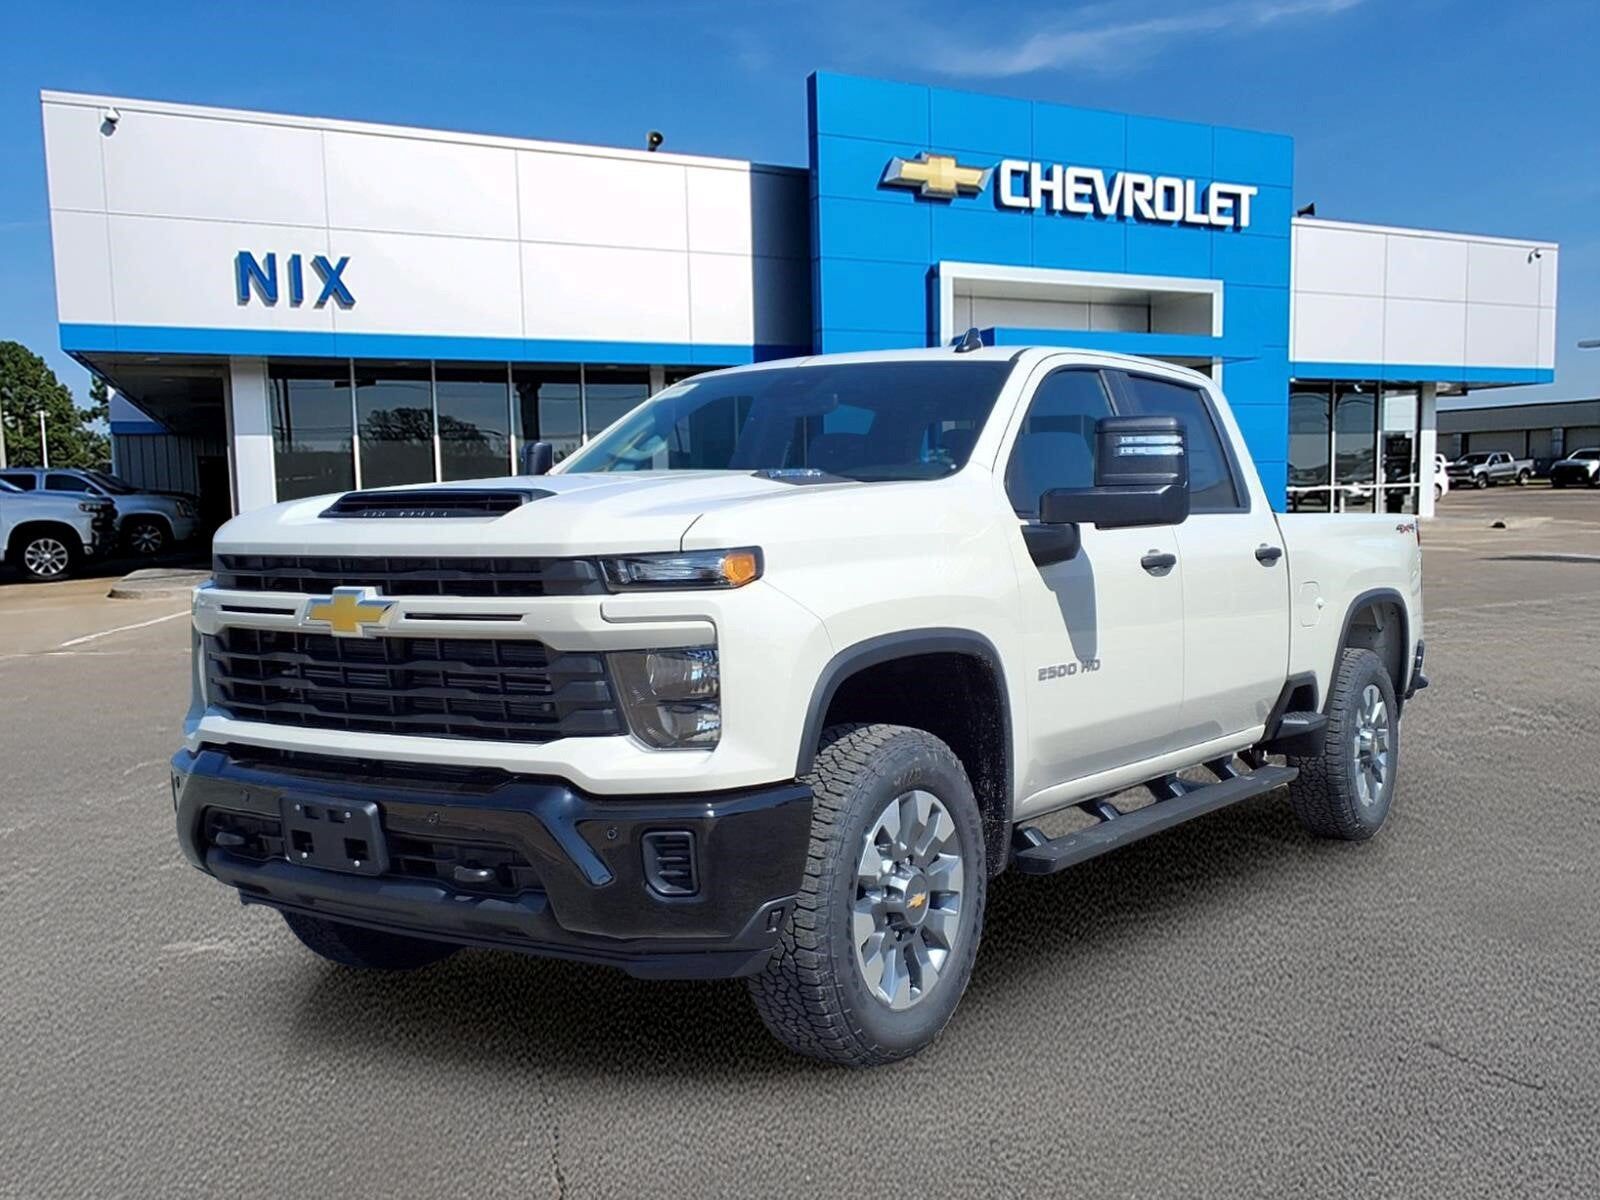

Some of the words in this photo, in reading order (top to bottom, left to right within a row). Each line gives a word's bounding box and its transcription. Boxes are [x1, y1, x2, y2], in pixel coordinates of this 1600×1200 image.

[997, 159, 1258, 228] CHEVROLET
[235, 250, 356, 309] NIX
[1038, 662, 1077, 681] 2500
[1081, 659, 1101, 673] HD
